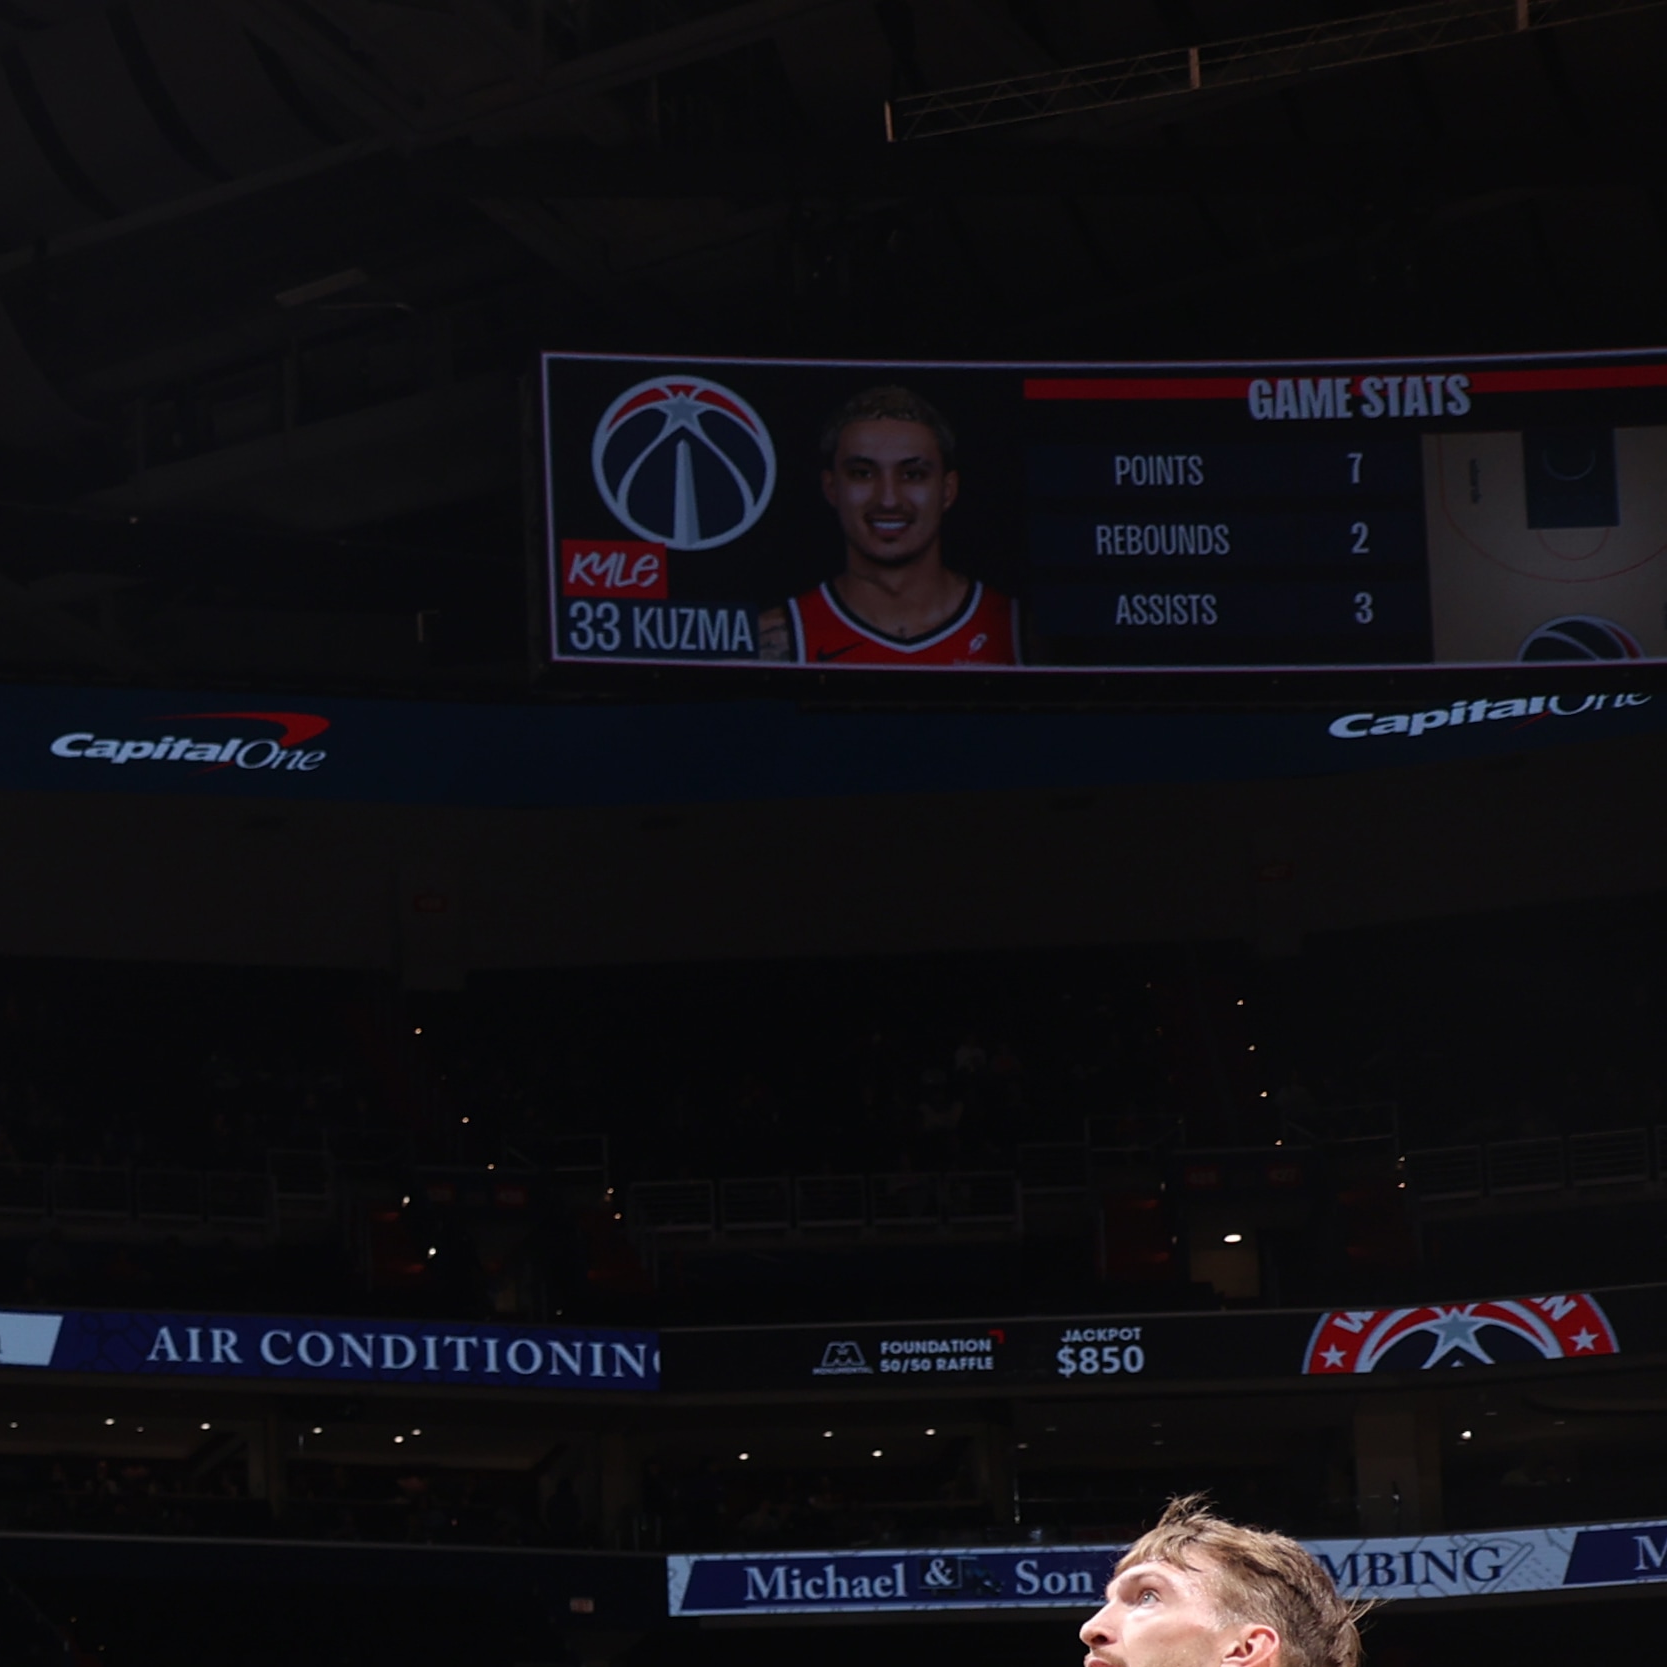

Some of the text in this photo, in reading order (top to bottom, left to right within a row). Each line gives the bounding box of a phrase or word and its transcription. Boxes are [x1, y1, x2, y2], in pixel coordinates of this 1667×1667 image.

[1247, 373, 1472, 421] GAME STATS
[1114, 452, 1364, 487] POINTS 7
[1095, 522, 1370, 556] REBOUNDS 2
[1115, 592, 1374, 626] ASSISTS 3
[569, 601, 755, 654] 33 KUZMA
[147, 1326, 243, 1365] AIR
[880, 1339, 992, 1355] FOUNDATION
[1061, 1327, 1142, 1343] JACKPOT
[879, 1356, 994, 1374] 50/50 RAFFLE
[1057, 1346, 1145, 1376] $850
[744, 1562, 907, 1602] Michael
[1015, 1556, 1093, 1597] Son
